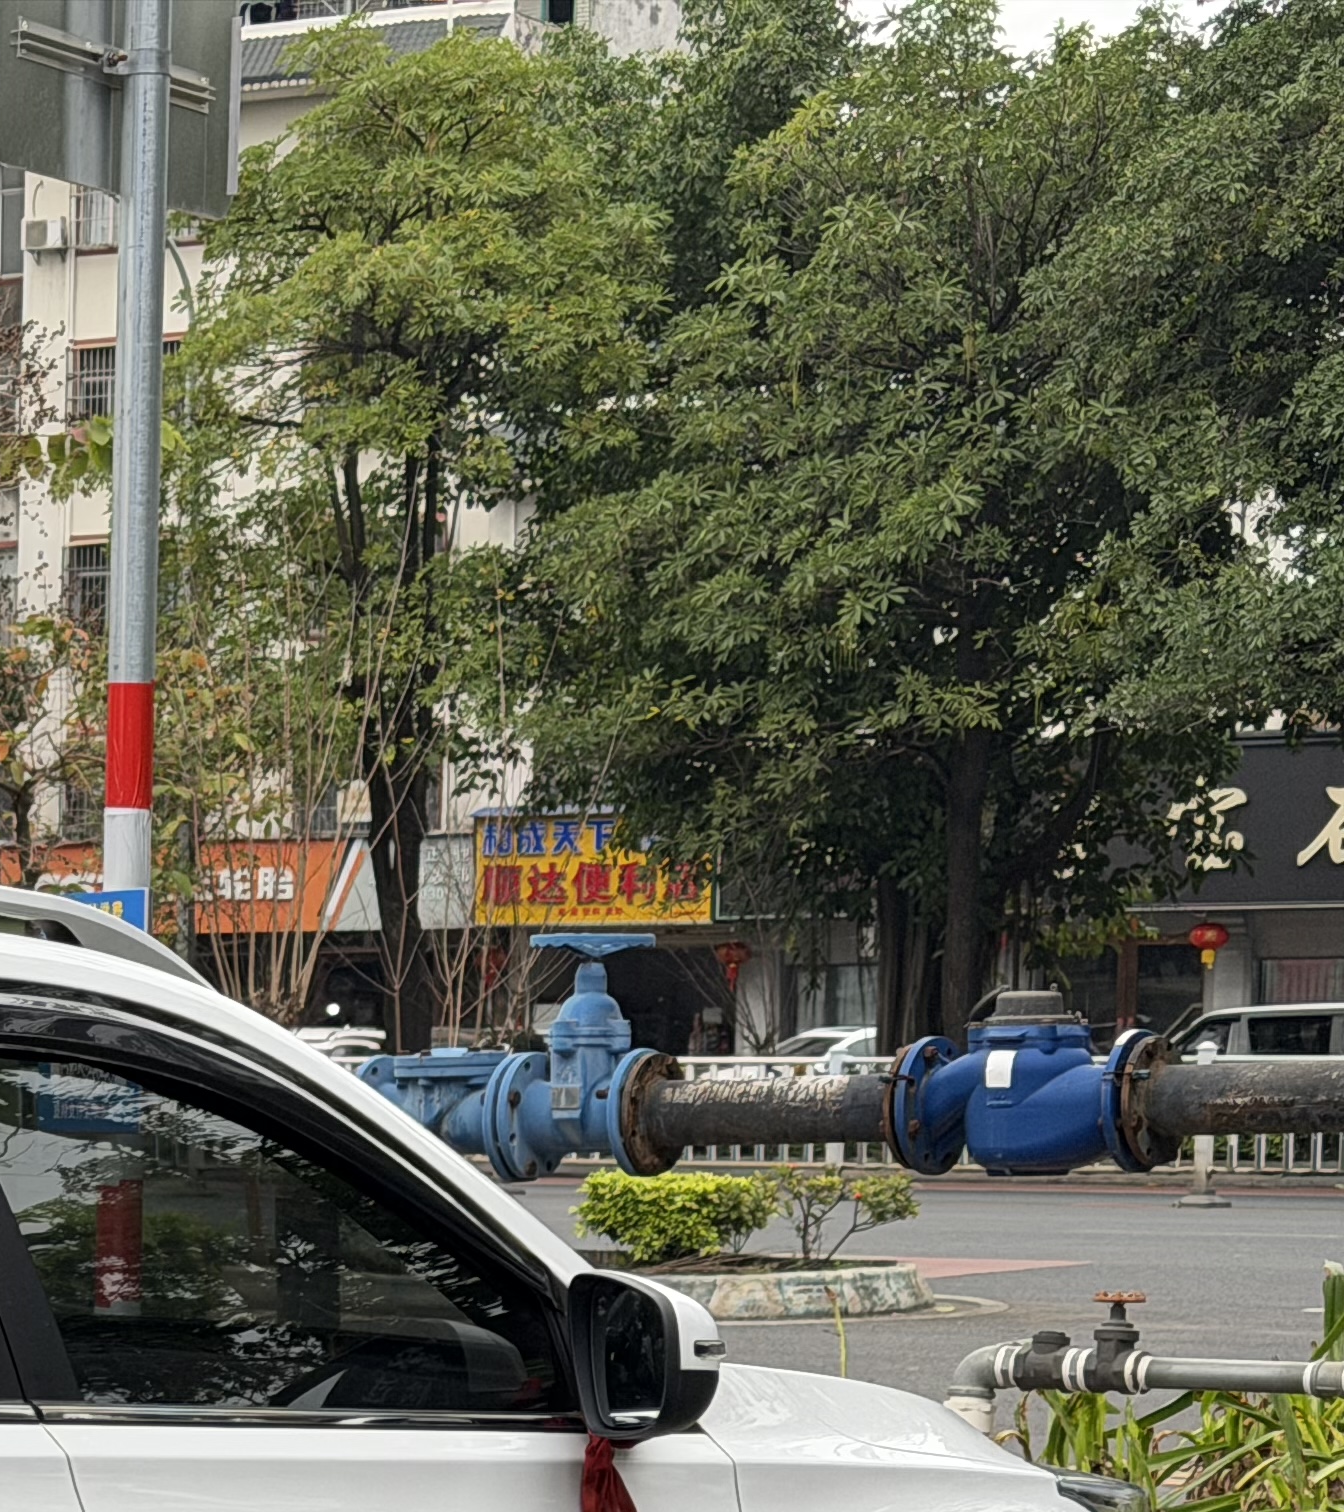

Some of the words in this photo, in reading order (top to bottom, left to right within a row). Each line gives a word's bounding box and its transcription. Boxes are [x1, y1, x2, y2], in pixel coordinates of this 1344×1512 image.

[482, 820, 660, 857] 和成天下
[196, 866, 294, 900] 轮胎
